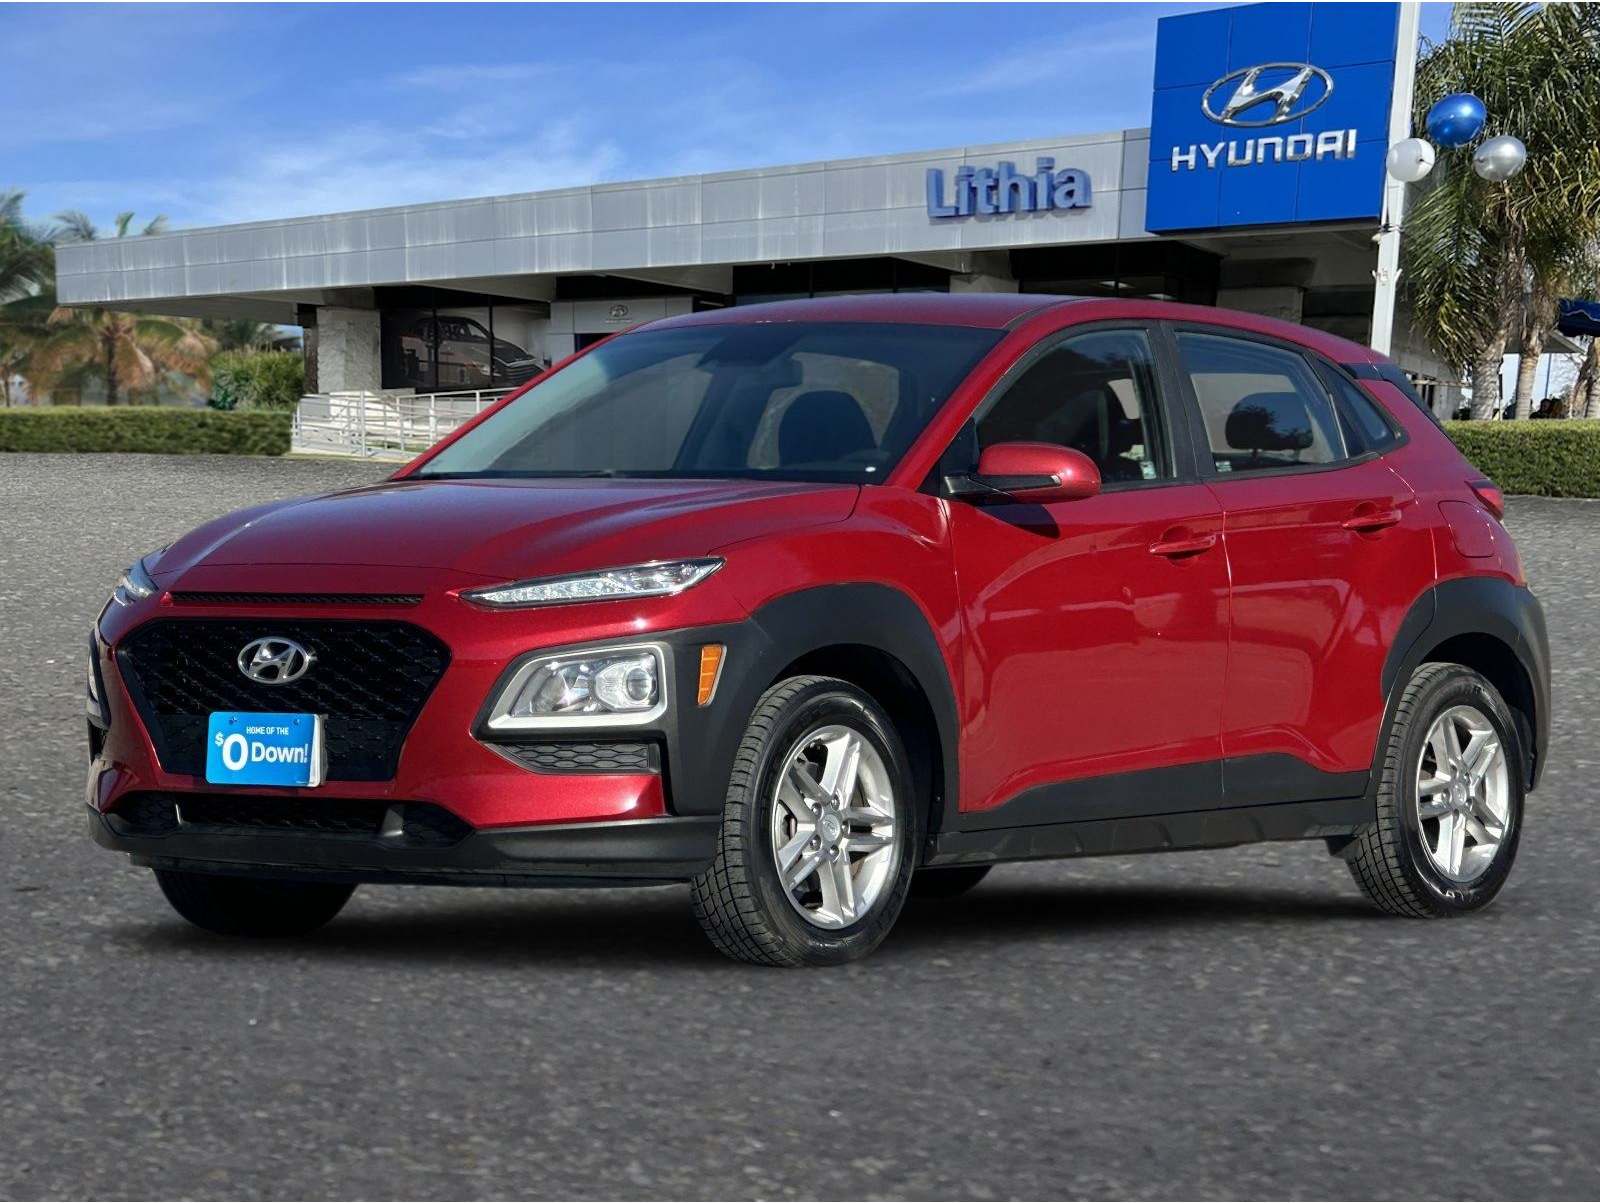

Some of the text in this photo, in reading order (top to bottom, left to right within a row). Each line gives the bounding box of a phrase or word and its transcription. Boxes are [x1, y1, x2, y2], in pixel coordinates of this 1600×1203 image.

[1171, 128, 1357, 171] HYUNDAI
[926, 156, 1092, 218] Lithia
[246, 726, 289, 736] HOME OF THE
[251, 742, 309, 764] Down!
